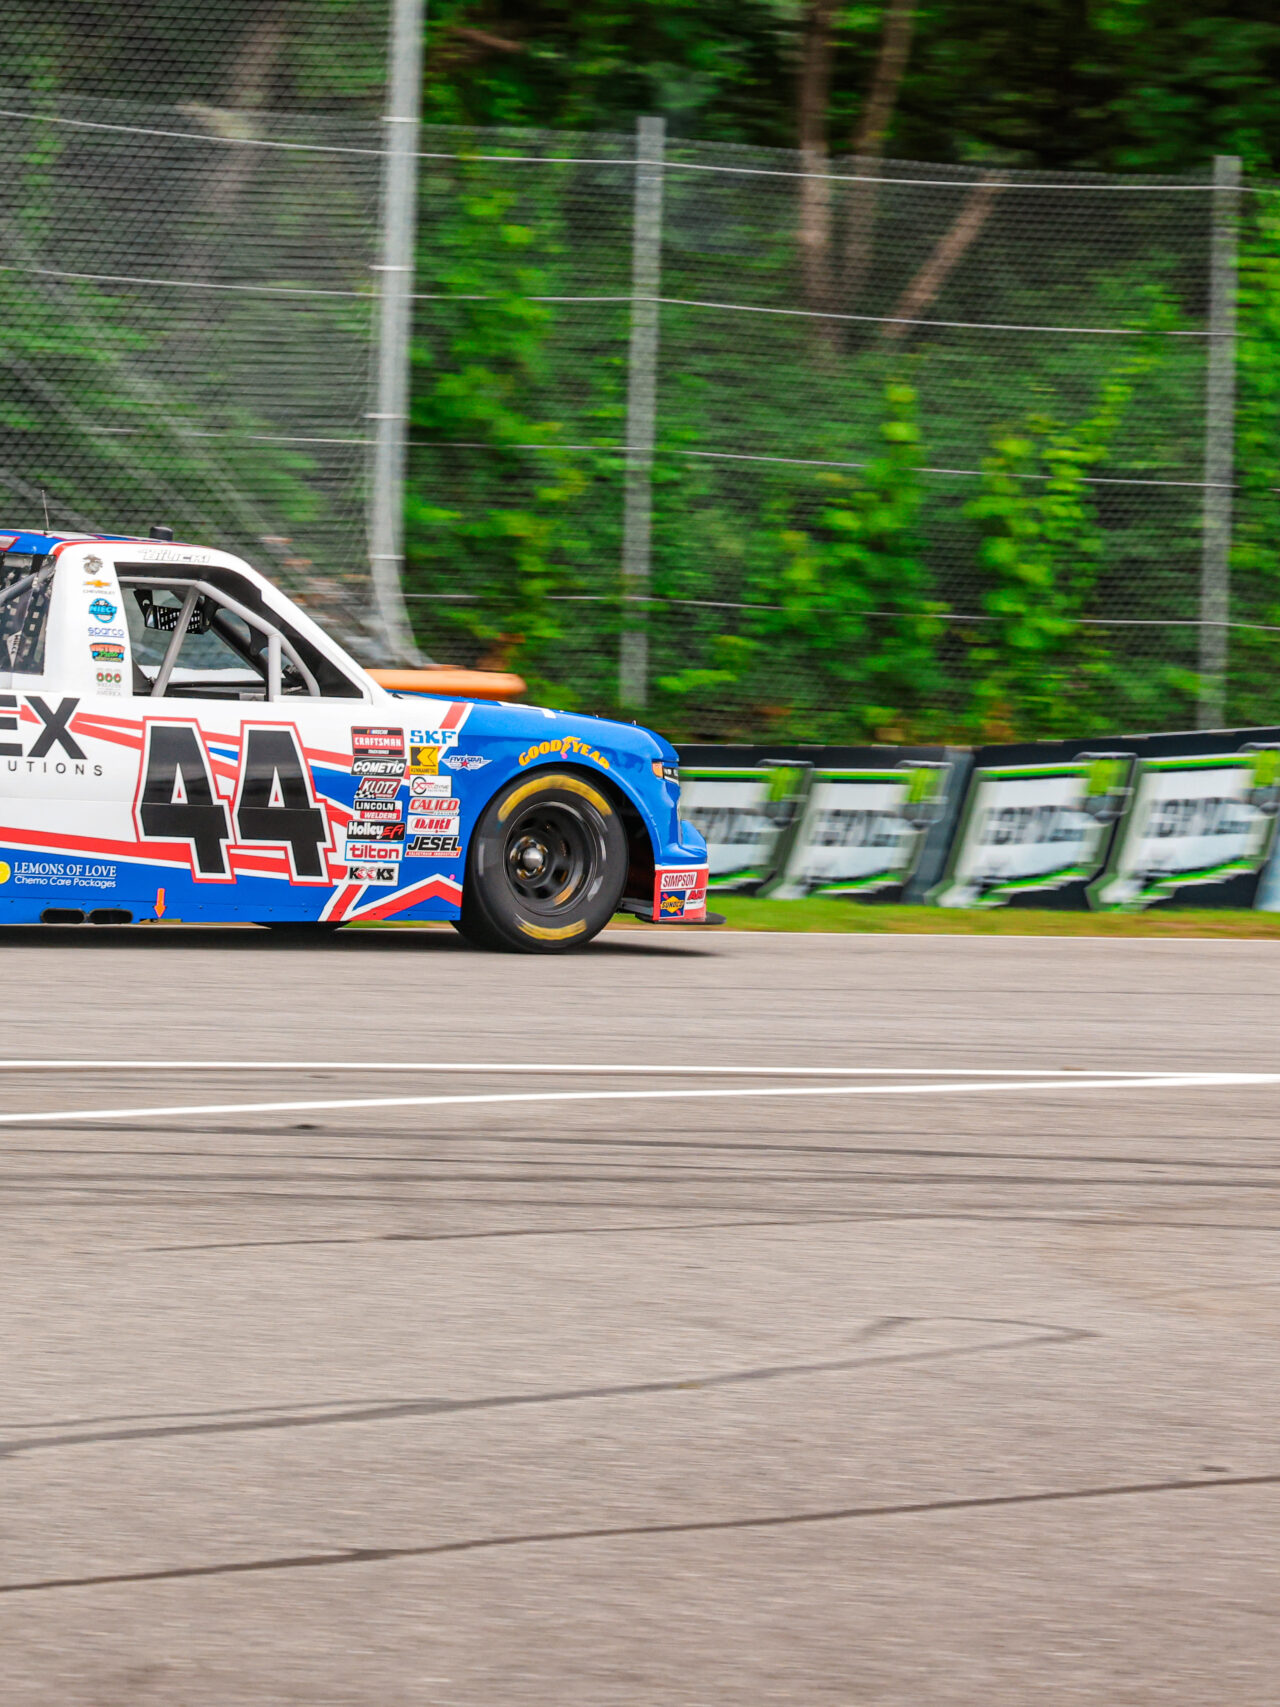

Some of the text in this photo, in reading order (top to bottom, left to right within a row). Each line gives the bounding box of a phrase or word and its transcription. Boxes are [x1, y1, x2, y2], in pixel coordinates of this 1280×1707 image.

[88, 627, 125, 637] sparco
[354, 736, 402, 747] CRAFTSMAN
[410, 729, 457, 744] SKF
[518, 736, 610, 770] GOODYEAR
[353, 760, 405, 773] COMETIC
[361, 780, 398, 795] KLOTZ
[140, 724, 327, 878] 44
[355, 802, 394, 810] LINCOLN
[410, 799, 459, 811] CALICO
[348, 822, 384, 839] Holley
[407, 836, 459, 851] JESEL
[350, 844, 400, 859] tilton
[14, 862, 117, 877] LEMONS OF LOVE
[14, 876, 117, 889] Chemo Care Packages
[663, 874, 696, 888] SIMPSON
